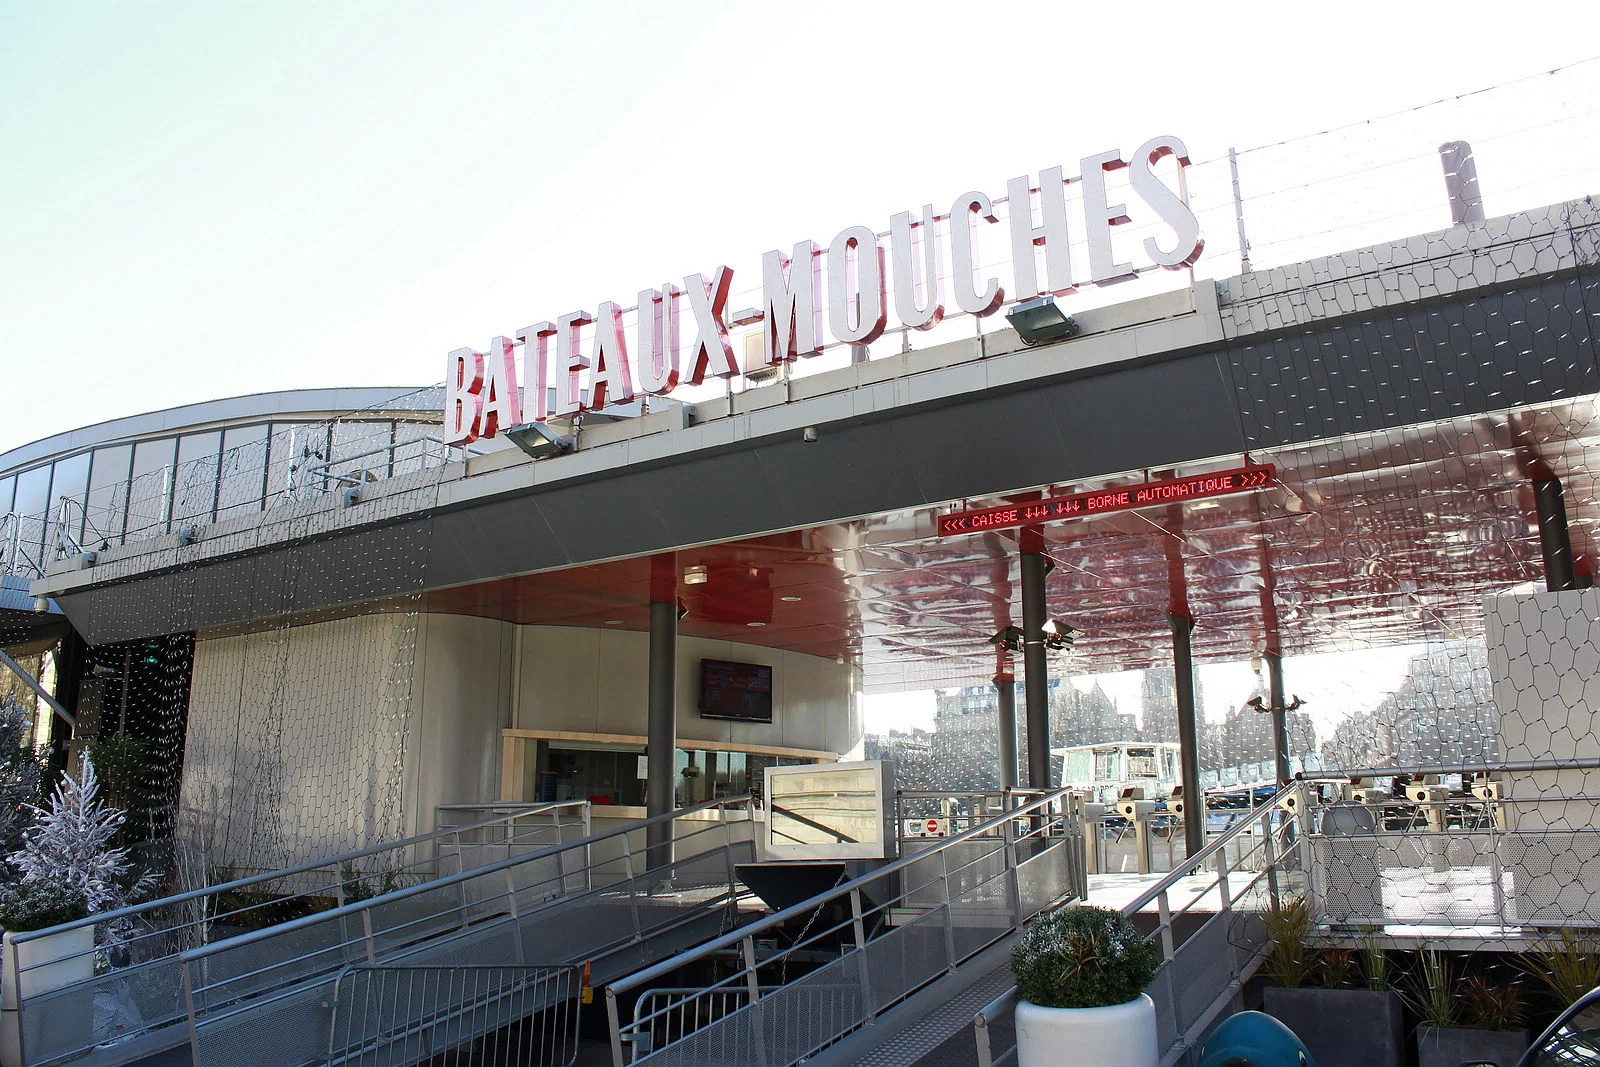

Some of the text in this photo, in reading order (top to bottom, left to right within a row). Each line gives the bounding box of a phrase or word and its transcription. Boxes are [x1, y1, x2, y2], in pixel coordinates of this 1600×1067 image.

[443, 136, 1204, 446] BATEAUX-MOUCHES
[971, 476, 1233, 527] CAISSE BORNE AUTOMATIQUE
